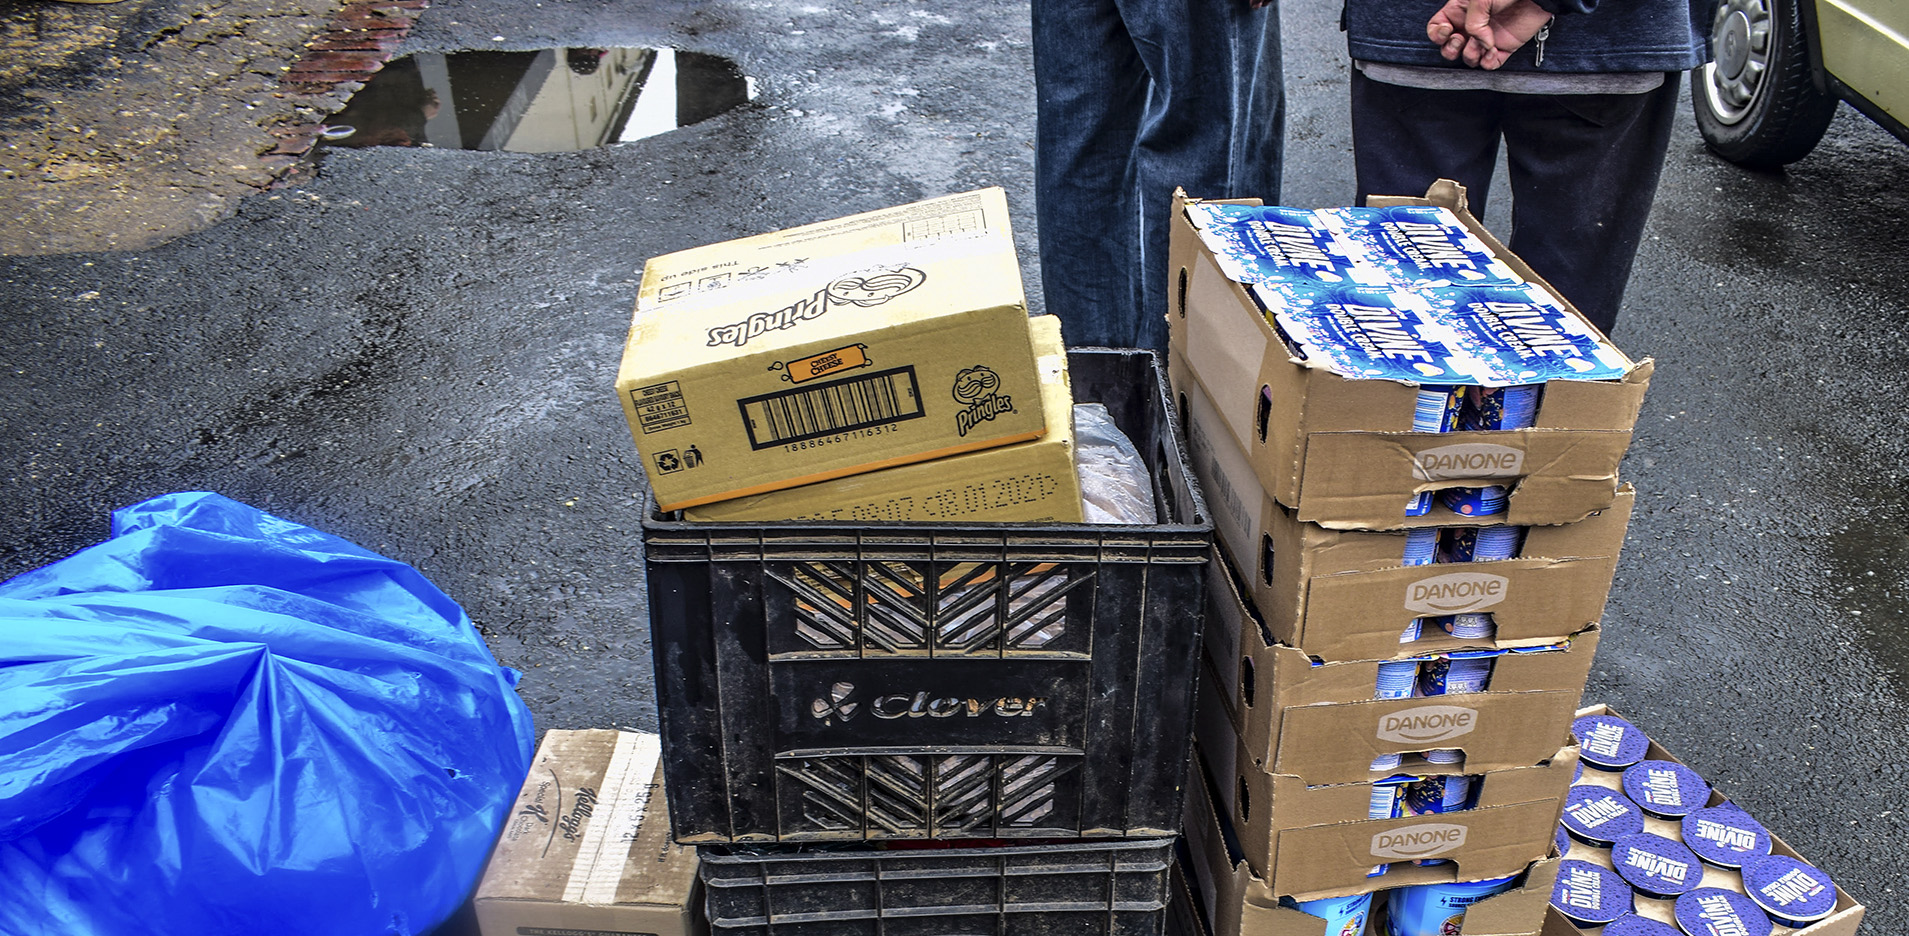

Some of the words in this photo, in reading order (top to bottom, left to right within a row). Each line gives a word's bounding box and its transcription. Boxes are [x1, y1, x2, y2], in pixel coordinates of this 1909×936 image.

[1264, 221, 1336, 272] DIVINE
[1395, 221, 1477, 270] DIVINE
[660, 273, 676, 281] up
[681, 266, 708, 277] side
[711, 260, 738, 270] This
[706, 288, 829, 347] Pringles
[1484, 301, 1583, 357] DIVINE
[1342, 303, 1434, 363] DIVINE
[810, 353, 837, 368] CHEESY
[810, 358, 843, 376] CHEESE
[956, 394, 1012, 437] Pringles
[784, 424, 898, 452] 18886467116312
[1423, 453, 1516, 470] DANONE
[1413, 580, 1501, 602] DANONE
[870, 691, 1048, 720] Clover
[1386, 712, 1471, 732] DANONE
[1589, 723, 1616, 757] DIVINE
[535, 781, 551, 805] Special
[1649, 768, 1672, 803] DIVINE
[519, 804, 548, 823] K
[559, 787, 597, 843] Kellogg's
[620, 831, 639, 842] 12
[633, 791, 652, 804] 25
[1570, 794, 1622, 825] DIVINE
[1378, 828, 1461, 849] DANONE
[1694, 825, 1755, 849] DIVINE
[1625, 851, 1686, 879] DIVINE
[1569, 866, 1591, 907] DIVINE
[1766, 872, 1818, 907] DIVINE
[1696, 895, 1739, 936] DIVINE
